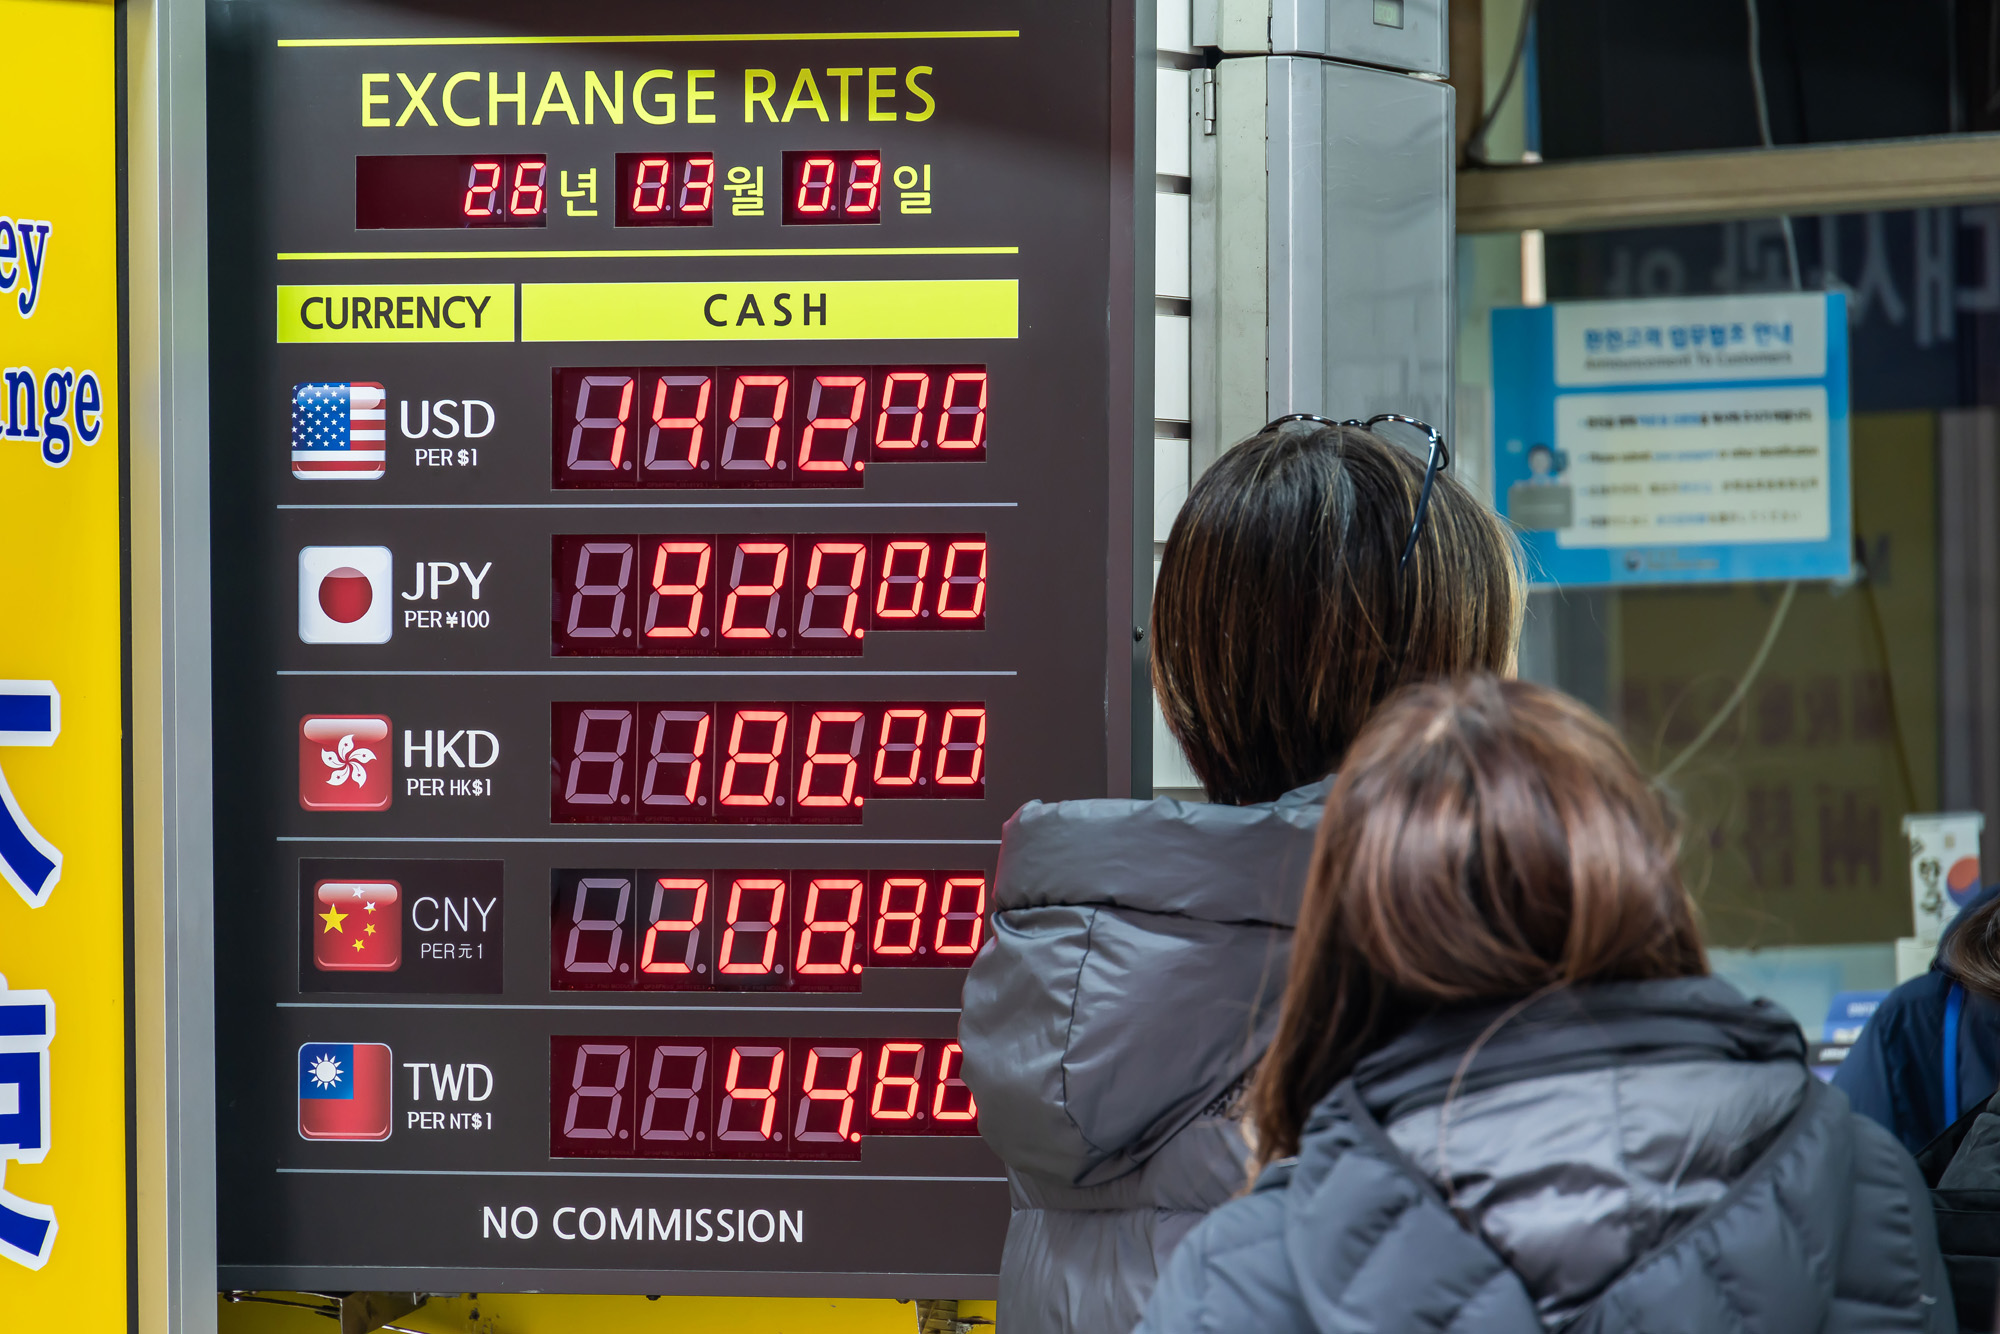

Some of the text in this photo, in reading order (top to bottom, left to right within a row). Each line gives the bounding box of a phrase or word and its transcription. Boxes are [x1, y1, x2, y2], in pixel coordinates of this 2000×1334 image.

[362, 66, 935, 127] EXCHANGE RATES
[464, 157, 931, 216] 26 년 03 월 03 일
[301, 296, 491, 329] CURRENCY
[704, 293, 826, 326] CASH
[0, 371, 99, 463] nge
[401, 400, 495, 438] USD
[415, 449, 476, 466] PER $1
[402, 562, 492, 600] JPY
[405, 610, 489, 628] PER ¥100
[405, 730, 499, 767] HKD
[407, 779, 490, 796] PER HK$1
[413, 897, 496, 932] CNY
[422, 943, 454, 958] PER
[403, 1063, 493, 1101] TWD
[407, 1112, 491, 1129] PER NT$1
[484, 1207, 802, 1242] NO COMMISSION
